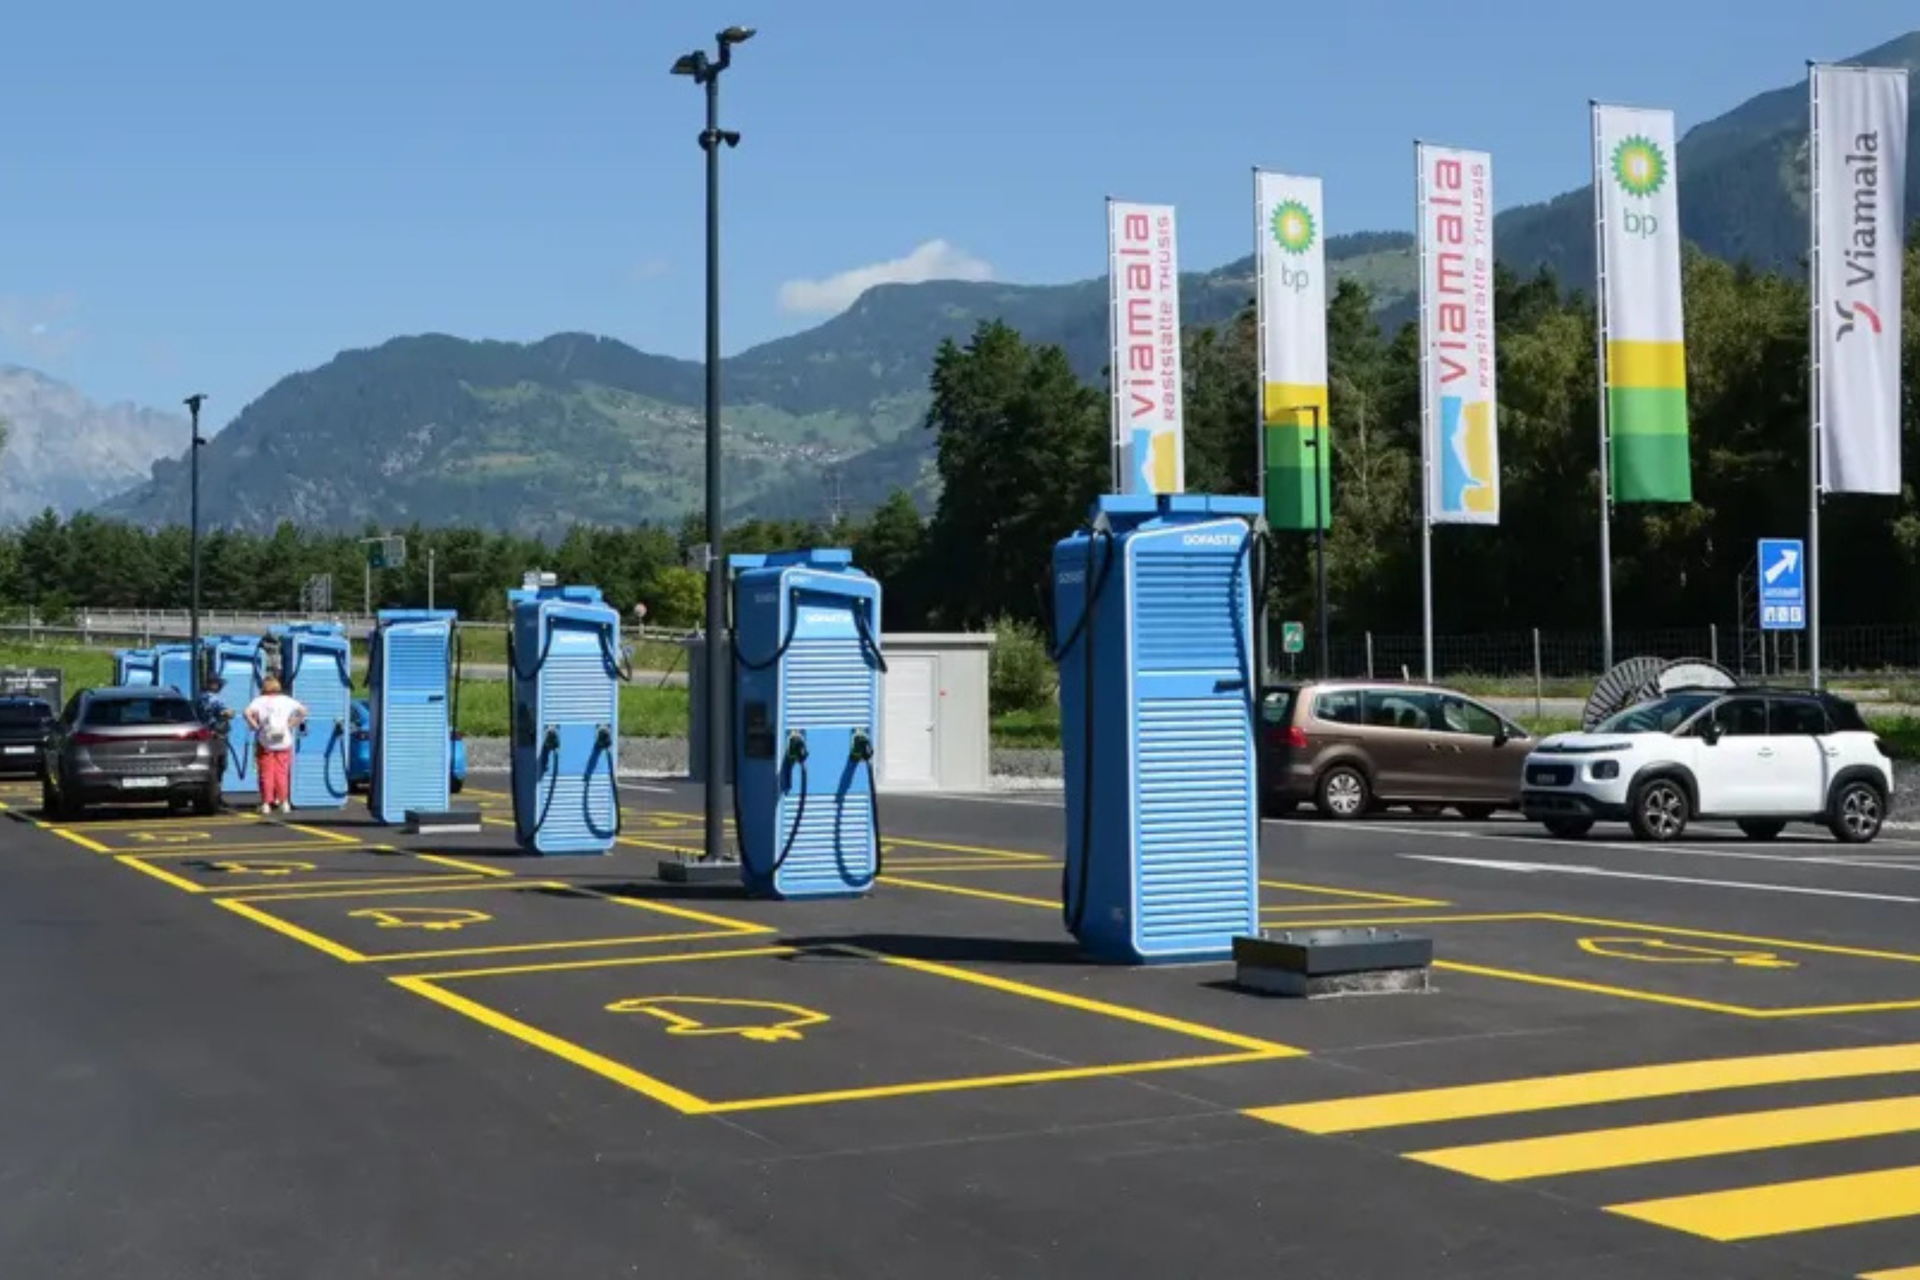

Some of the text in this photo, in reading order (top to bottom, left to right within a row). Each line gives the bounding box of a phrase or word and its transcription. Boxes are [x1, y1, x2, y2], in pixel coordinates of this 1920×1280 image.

[1156, 215, 1171, 291] THUSIS
[1622, 206, 1659, 240] bp
[1844, 131, 1878, 287] Viamala
[1120, 213, 1156, 418] viamala
[1281, 262, 1309, 294] bp
[1429, 159, 1468, 383] viamala
